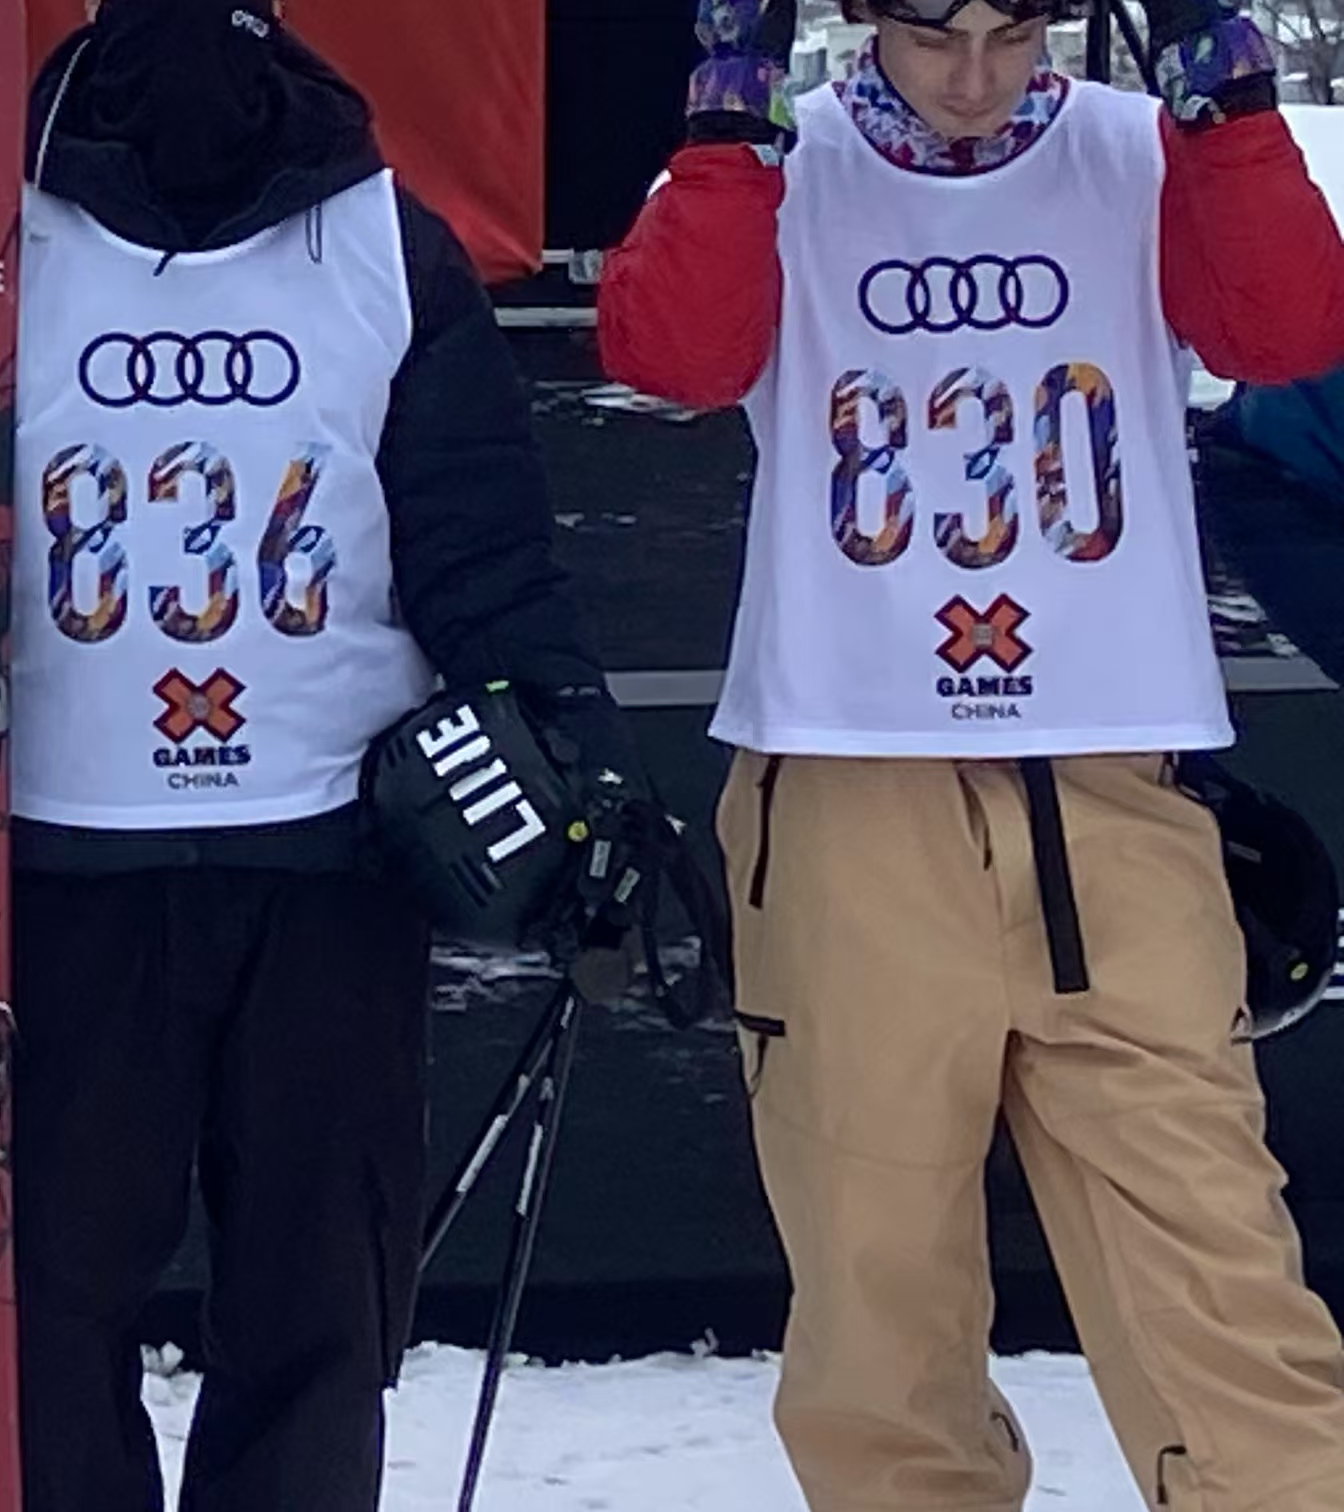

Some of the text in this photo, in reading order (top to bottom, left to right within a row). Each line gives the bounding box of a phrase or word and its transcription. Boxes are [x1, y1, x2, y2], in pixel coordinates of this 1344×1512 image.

[829, 361, 1125, 569] 830
[42, 441, 338, 644] 836
[935, 675, 1034, 697] GAMES
[950, 703, 1023, 721] CHINA
[152, 744, 252, 767] GAMES
[167, 772, 240, 789] CHINA
[416, 704, 546, 863] LINE
